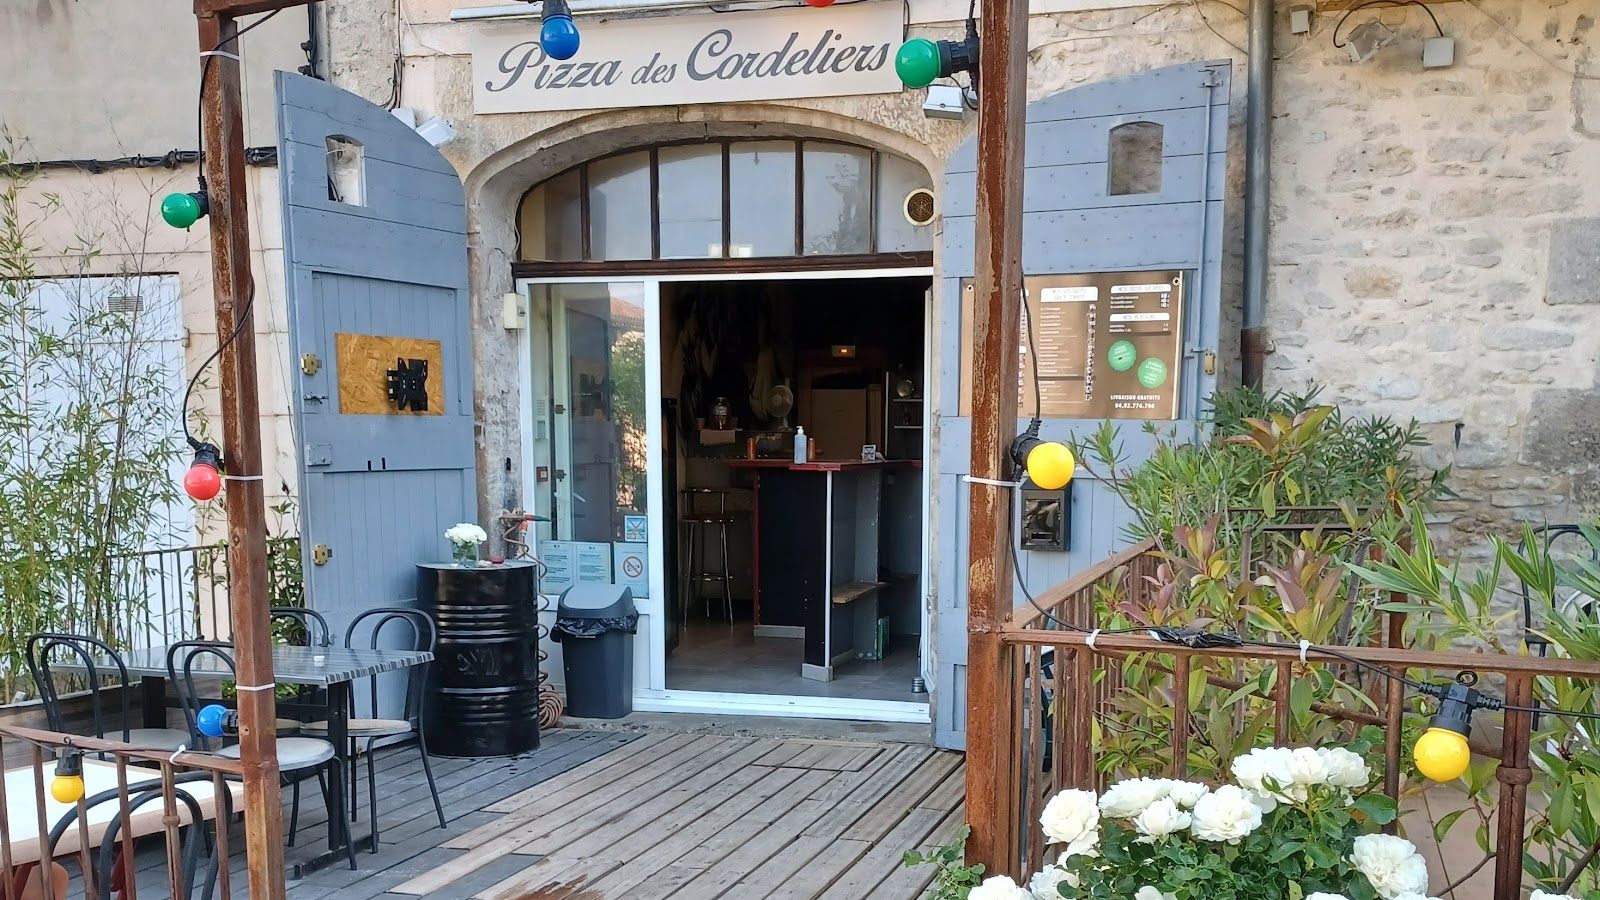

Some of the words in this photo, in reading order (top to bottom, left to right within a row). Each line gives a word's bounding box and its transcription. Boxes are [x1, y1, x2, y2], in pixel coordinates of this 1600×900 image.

[485, 41, 623, 93] Pizza
[631, 53, 678, 84] des
[686, 29, 891, 82] Cordeliers
